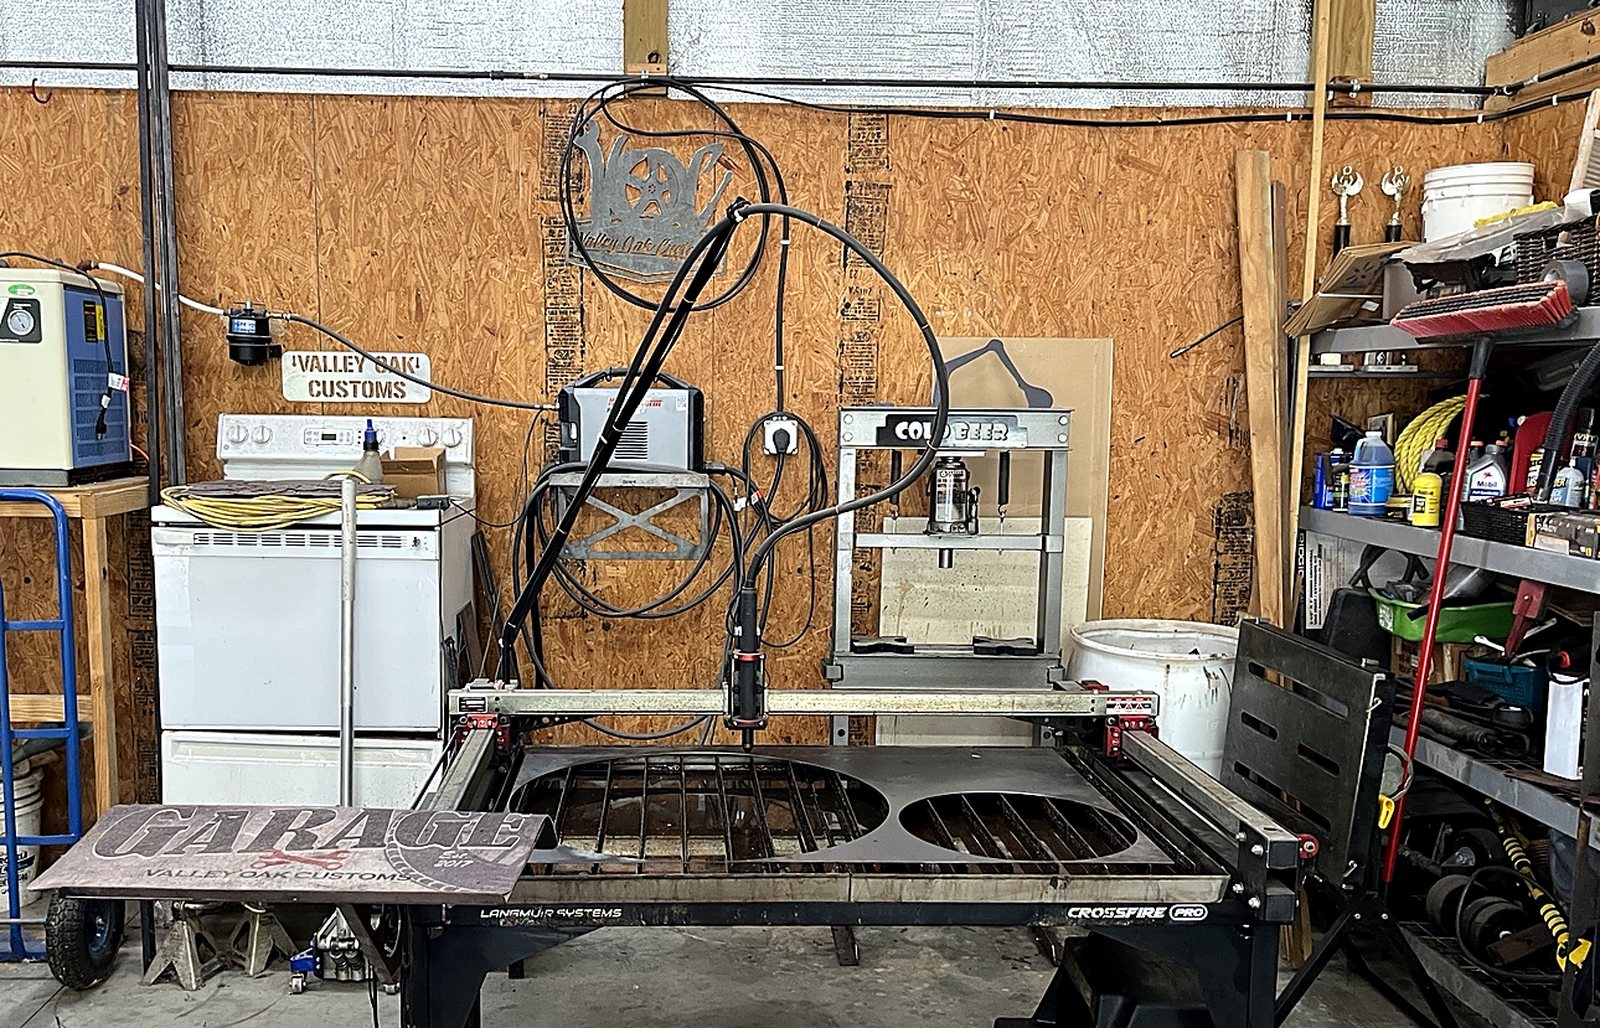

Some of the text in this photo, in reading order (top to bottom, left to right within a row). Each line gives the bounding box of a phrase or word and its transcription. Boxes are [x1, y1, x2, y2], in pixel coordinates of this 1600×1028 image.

[297, 355, 416, 374] VALLEY OAK
[308, 380, 407, 399] CUSTOMS
[953, 421, 1009, 441] BEER
[93, 808, 534, 860] GARAGE
[434, 859, 474, 869] 2017
[144, 868, 412, 882] VALLEY OAK CUSTOMS
[480, 907, 623, 919] LANGMUIR SYSTEMS
[1067, 906, 1204, 919] CROSSFIRE PRO
